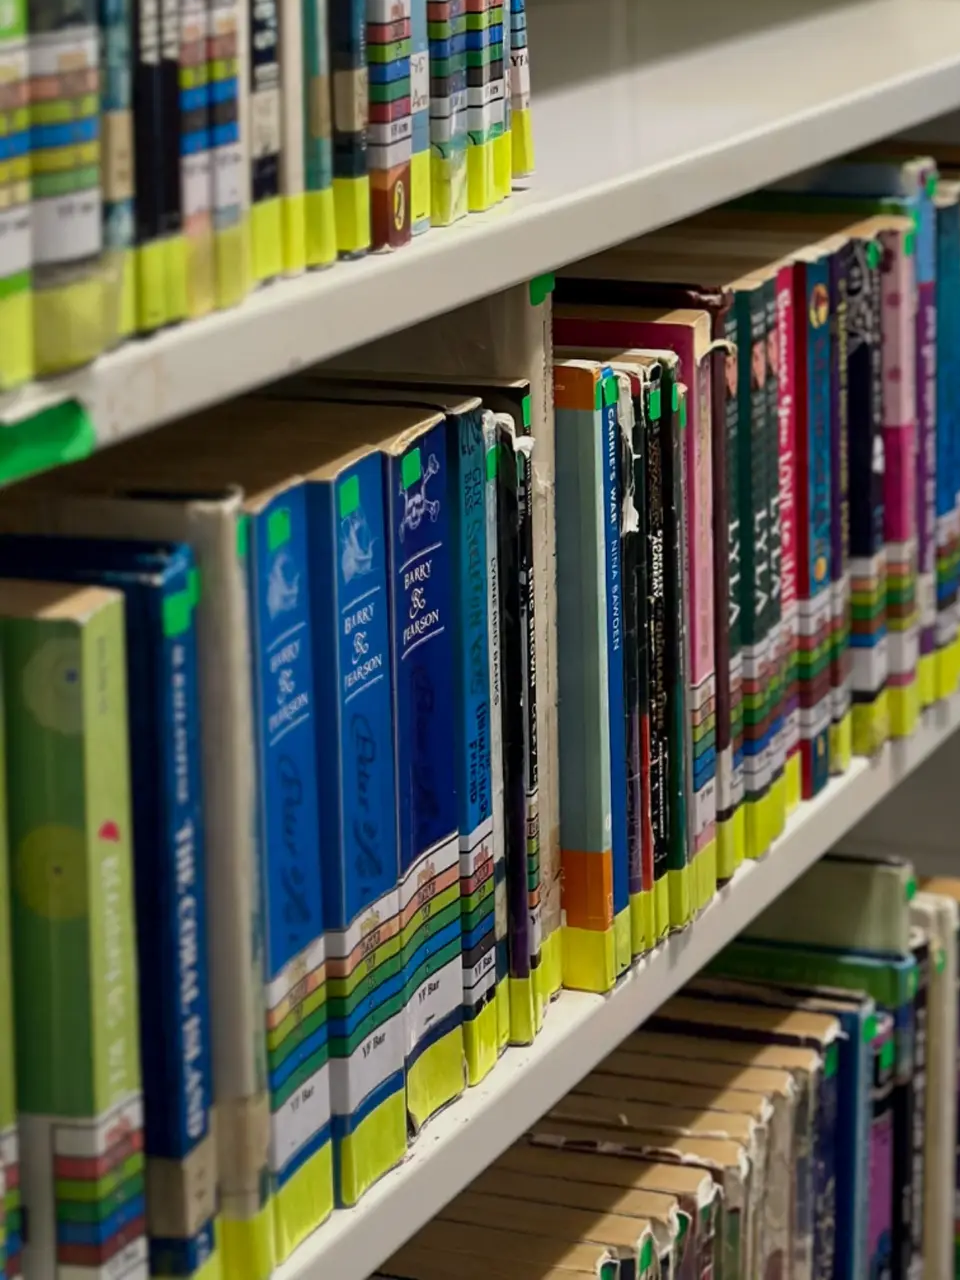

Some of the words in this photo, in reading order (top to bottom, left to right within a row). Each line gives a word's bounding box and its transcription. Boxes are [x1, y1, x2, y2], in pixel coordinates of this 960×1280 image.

[607, 408, 616, 482] CARRIE'S
[464, 471, 473, 517] BASS
[471, 467, 482, 507] GUY
[754, 509, 768, 617] LYLA
[770, 494, 781, 601] LYLA
[404, 559, 433, 592] BARRY
[490, 557, 498, 610] LYNNE
[527, 567, 536, 612] ERIC
[727, 519, 741, 628] LYLA
[344, 601, 376, 635] BARRY
[409, 587, 427, 620] &
[612, 585, 622, 651] BAWDEN
[351, 630, 370, 665] &
[402, 608, 440, 646] PEARSON
[269, 638, 301, 675] BARRY
[344, 653, 383, 693] PEARSON
[529, 617, 537, 689] BROWN
[492, 650, 500, 706] BANKS
[267, 690, 309, 734] PEARSON
[174, 819, 196, 887] THE
[177, 894, 201, 1009] CORAL
[418, 987, 429, 1005] YF
[427, 979, 440, 996] Bar
[362, 1043, 372, 1058] YF
[371, 1031, 387, 1050] Bar
[181, 1013, 206, 1139] ISLAND
